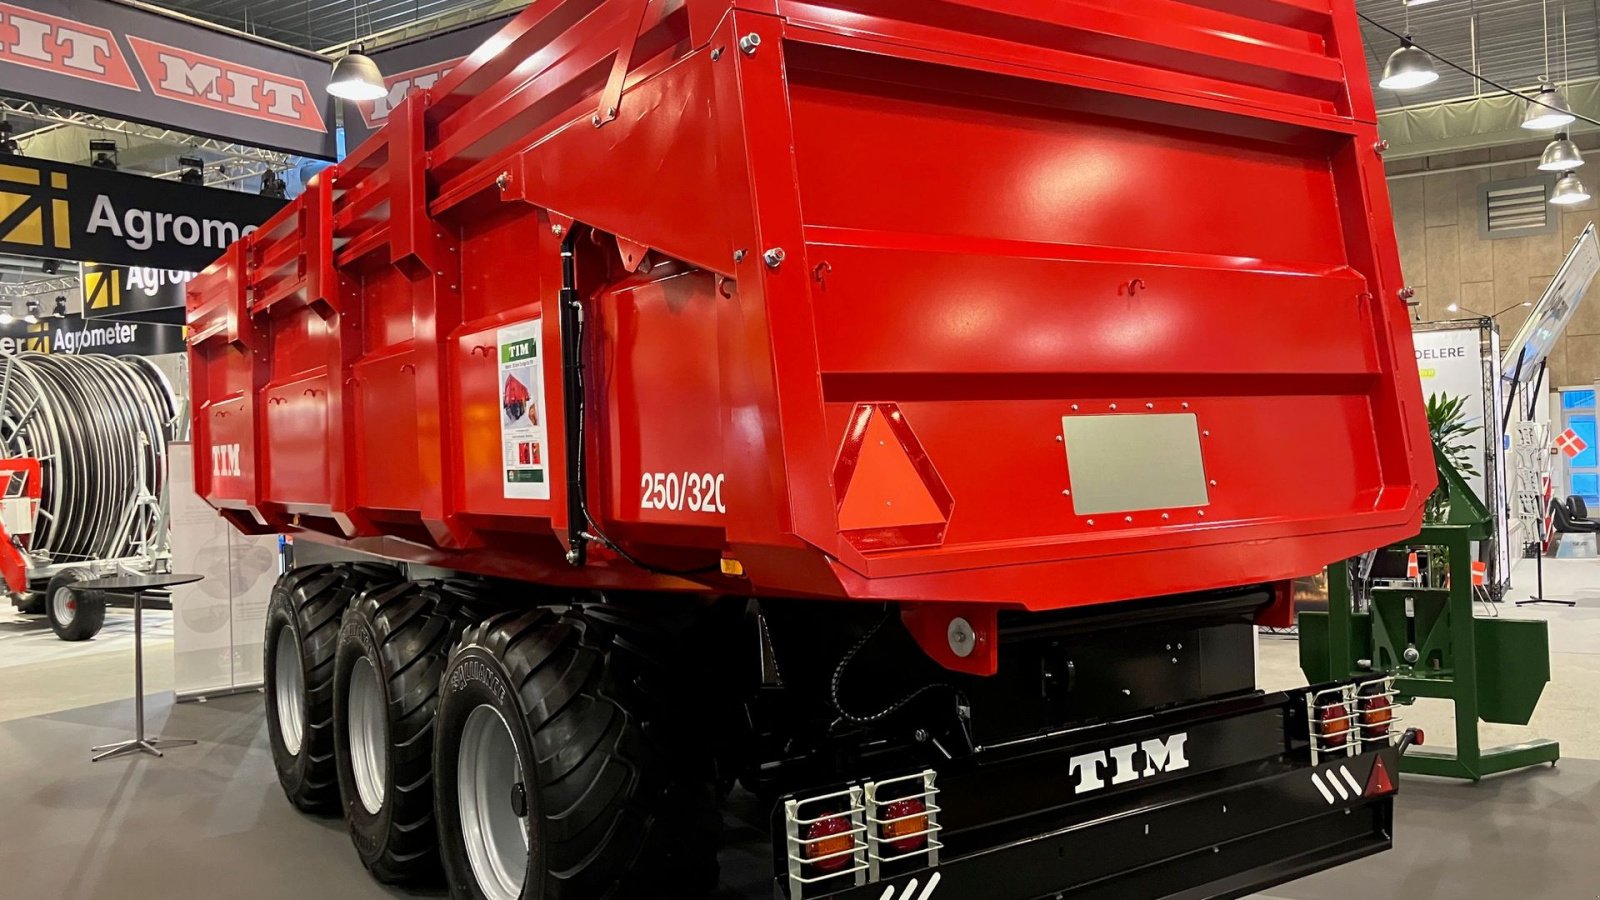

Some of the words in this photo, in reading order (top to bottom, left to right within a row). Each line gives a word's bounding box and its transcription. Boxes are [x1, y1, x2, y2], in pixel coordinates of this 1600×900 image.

[0, 12, 111, 75] IT
[159, 53, 304, 119] MIT
[53, 322, 138, 354] Agrometer
[508, 342, 529, 358] TIM
[212, 443, 241, 477] TIM
[1068, 732, 1190, 795] TIM
